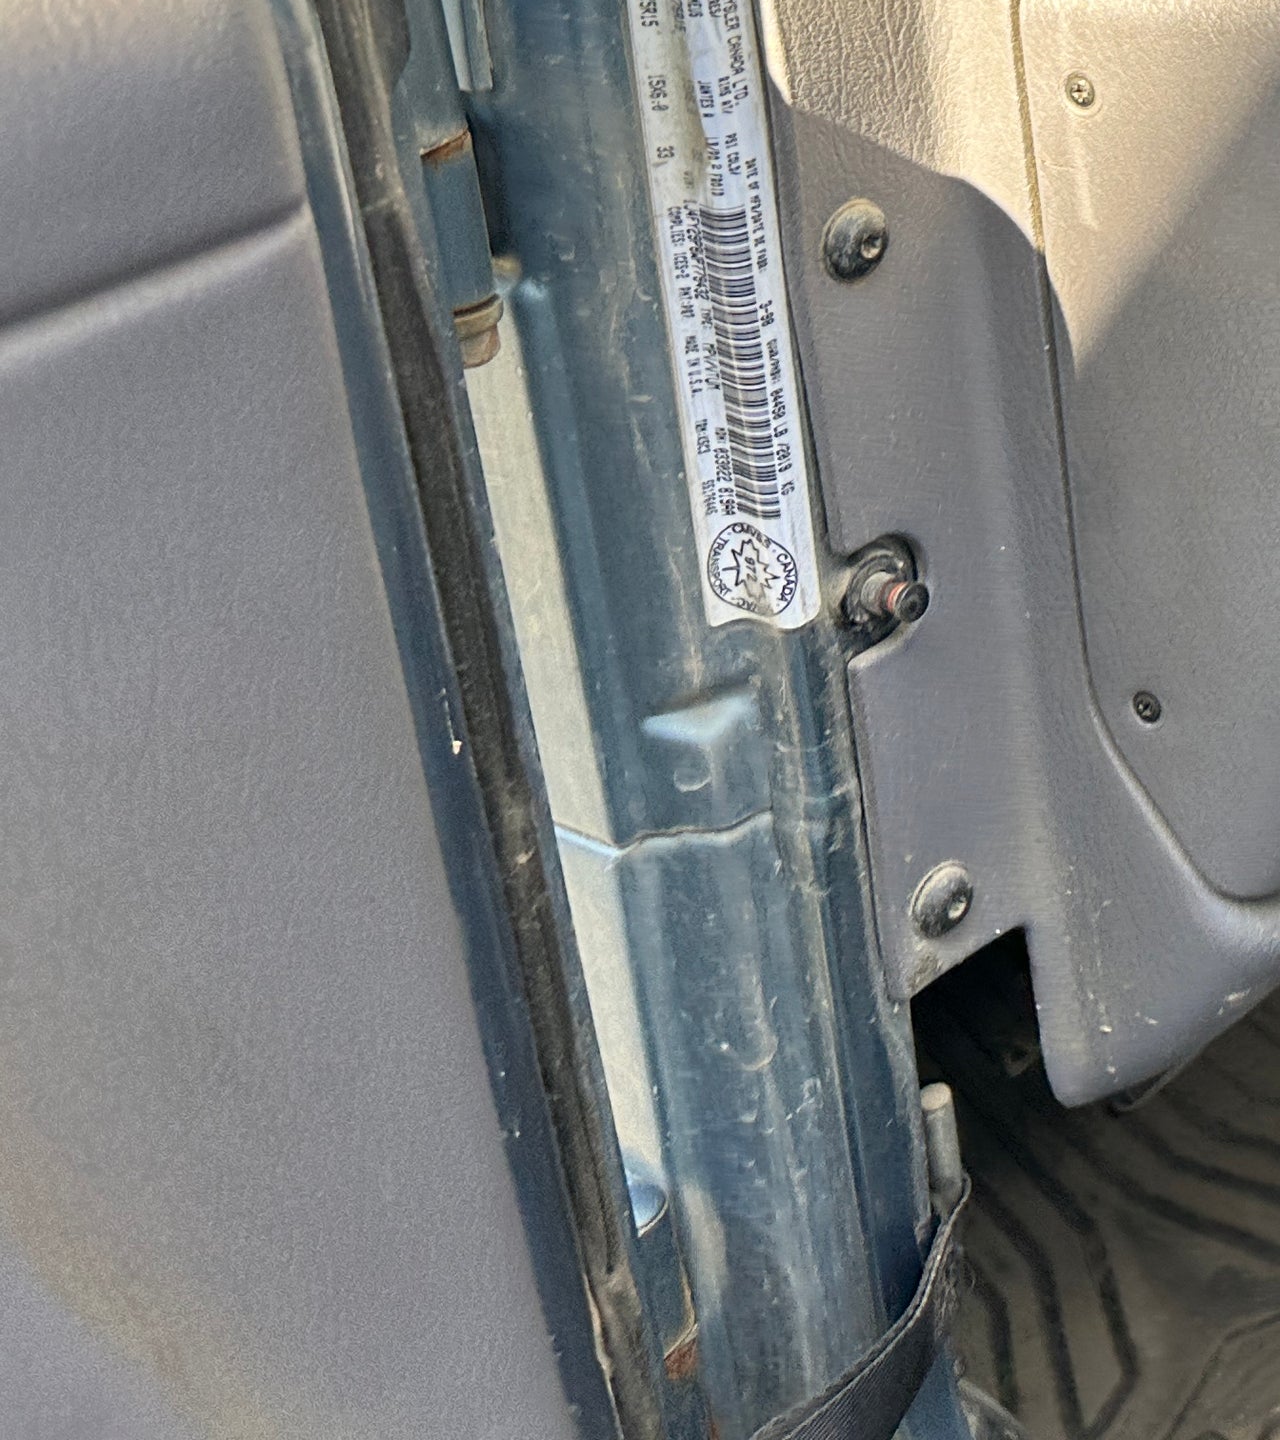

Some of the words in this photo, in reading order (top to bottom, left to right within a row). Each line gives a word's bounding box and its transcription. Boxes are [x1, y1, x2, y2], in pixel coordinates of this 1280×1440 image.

[727, 34, 743, 75] CANADA
[647, 74, 668, 112] 15X6.0
[718, 76, 729, 97] RIMS
[733, 79, 748, 106] LTD.
[721, 101, 733, 114] AT/
[697, 80, 711, 108] JANTES
[709, 173, 724, 197] FROID
[725, 133, 737, 149] PSI
[657, 146, 674, 159] 33
[729, 153, 741, 176] COLD/
[745, 158, 758, 177] DATE
[668, 207, 683, 247] COMPLIES:
[759, 300, 774, 327] 3-98
[685, 336, 699, 354] MADE
[688, 358, 701, 368] IN
[688, 371, 703, 399] U.S.A.
[771, 390, 783, 420] 04450
[774, 425, 787, 438] LB
[714, 448, 731, 483] 033022
[782, 482, 795, 496] KG
[707, 537, 732, 597] TRANSPORT
[744, 556, 758, 582] 972
[777, 553, 797, 602] CANADA
